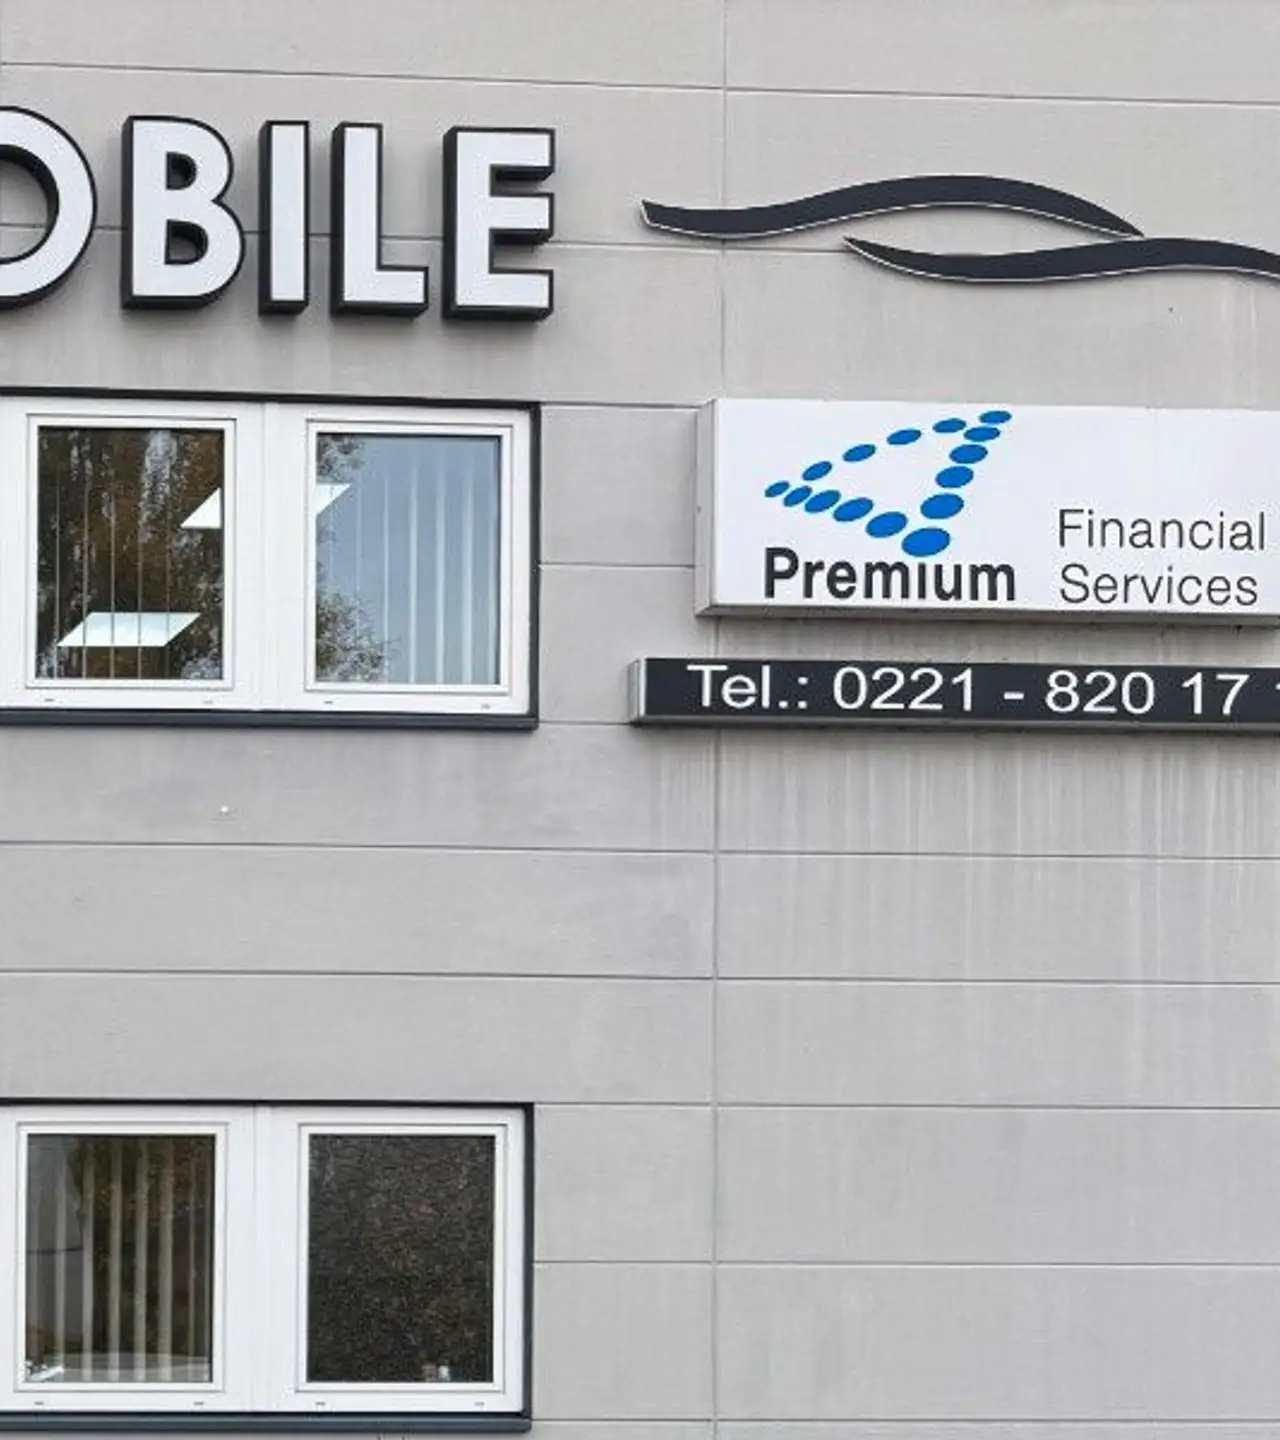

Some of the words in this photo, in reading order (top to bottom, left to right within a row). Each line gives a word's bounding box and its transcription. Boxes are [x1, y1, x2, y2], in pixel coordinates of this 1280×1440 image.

[1058, 508, 1266, 551] Financial
[763, 546, 1016, 603] Premium
[1059, 562, 1258, 607] Services
[687, 664, 808, 709] Tel.:
[833, 666, 974, 712] 0221
[1044, 669, 1156, 715] 820
[1181, 672, 1250, 716] 17
